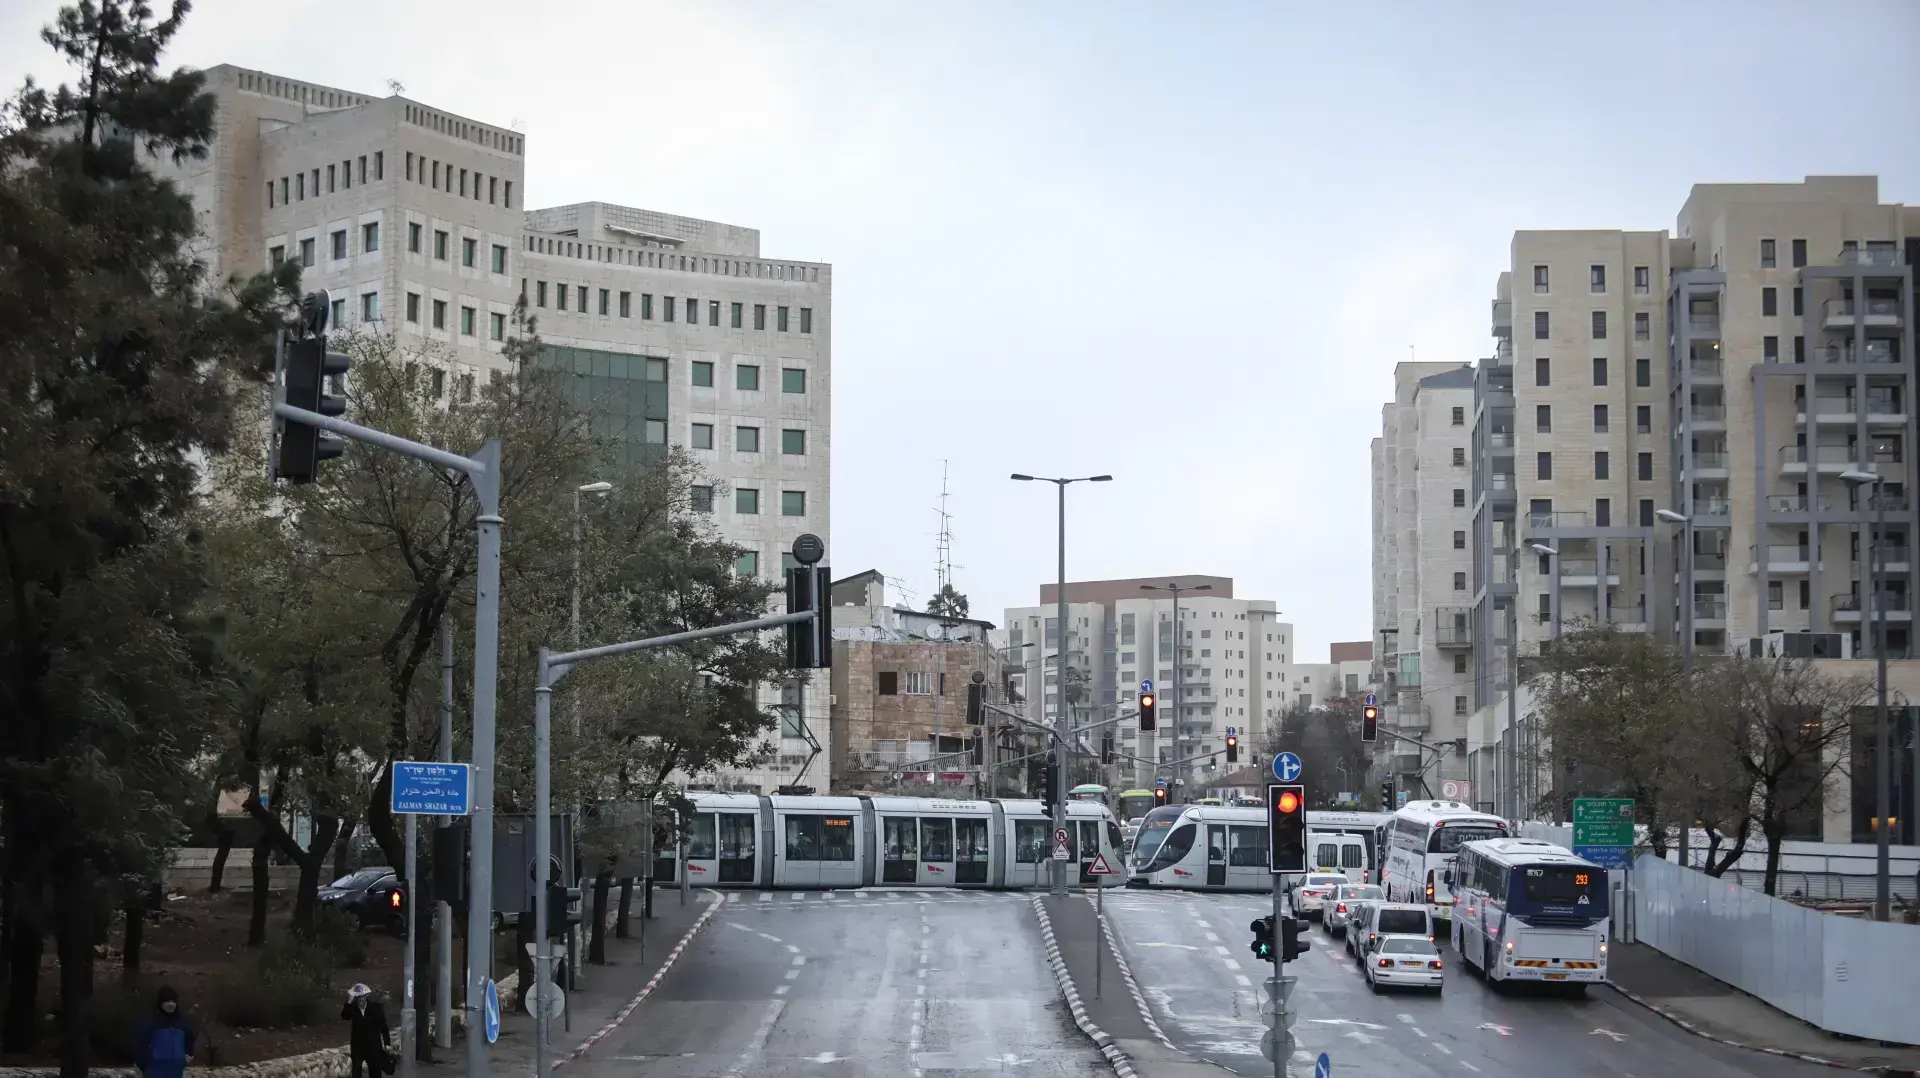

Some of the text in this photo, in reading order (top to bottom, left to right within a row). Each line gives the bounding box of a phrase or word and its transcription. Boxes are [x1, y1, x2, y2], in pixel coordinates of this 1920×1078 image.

[398, 801, 423, 810] ZALMAN
[424, 802, 448, 811] SHAZAR
[1575, 874, 1588, 885] 293
